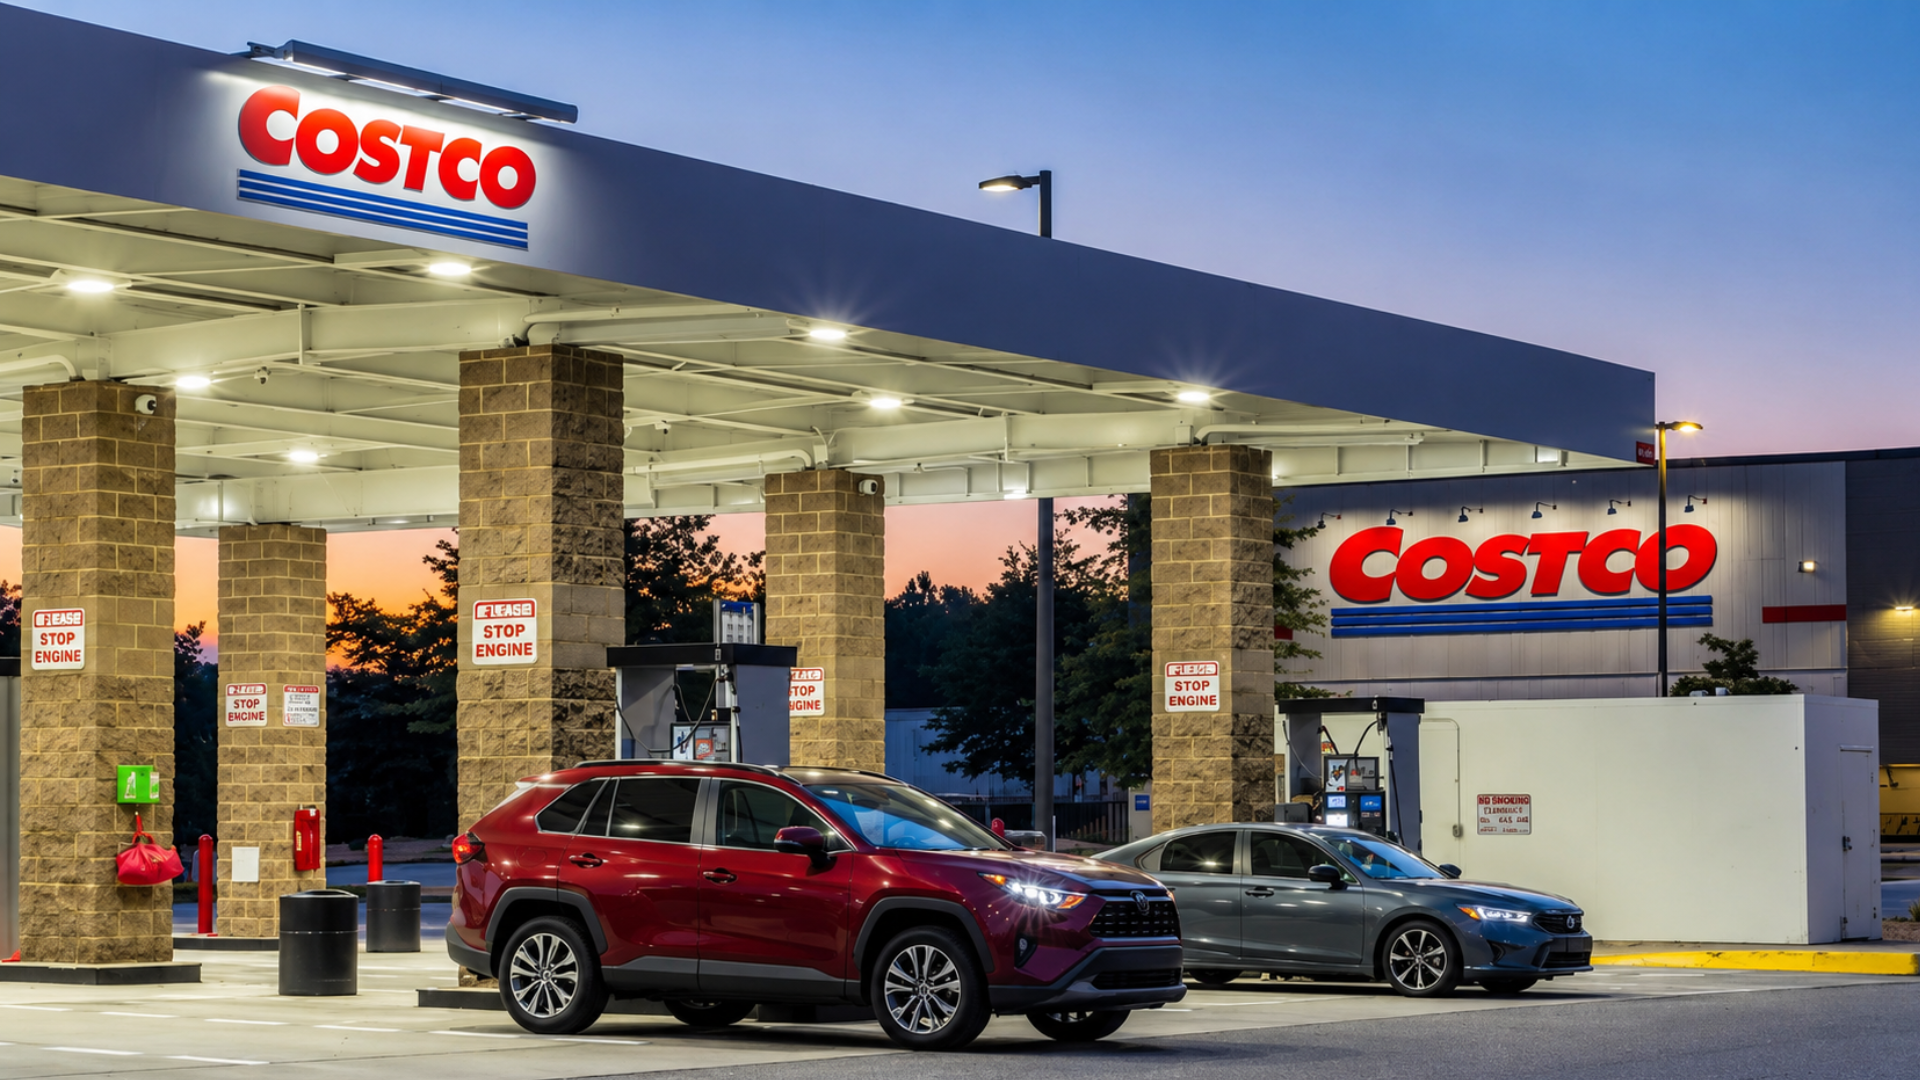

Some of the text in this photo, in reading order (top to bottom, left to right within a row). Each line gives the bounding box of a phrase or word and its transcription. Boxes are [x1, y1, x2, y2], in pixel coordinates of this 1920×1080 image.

[238, 85, 537, 209] COSTCO
[1329, 523, 1717, 603] COSTCO
[484, 624, 525, 639] STOP
[40, 632, 75, 646] STOP
[35, 649, 81, 663] ENGINE
[476, 642, 533, 657] ENGINE
[1174, 680, 1210, 692] STOP
[233, 699, 260, 709] STOP
[1169, 695, 1217, 706] ENGINE
